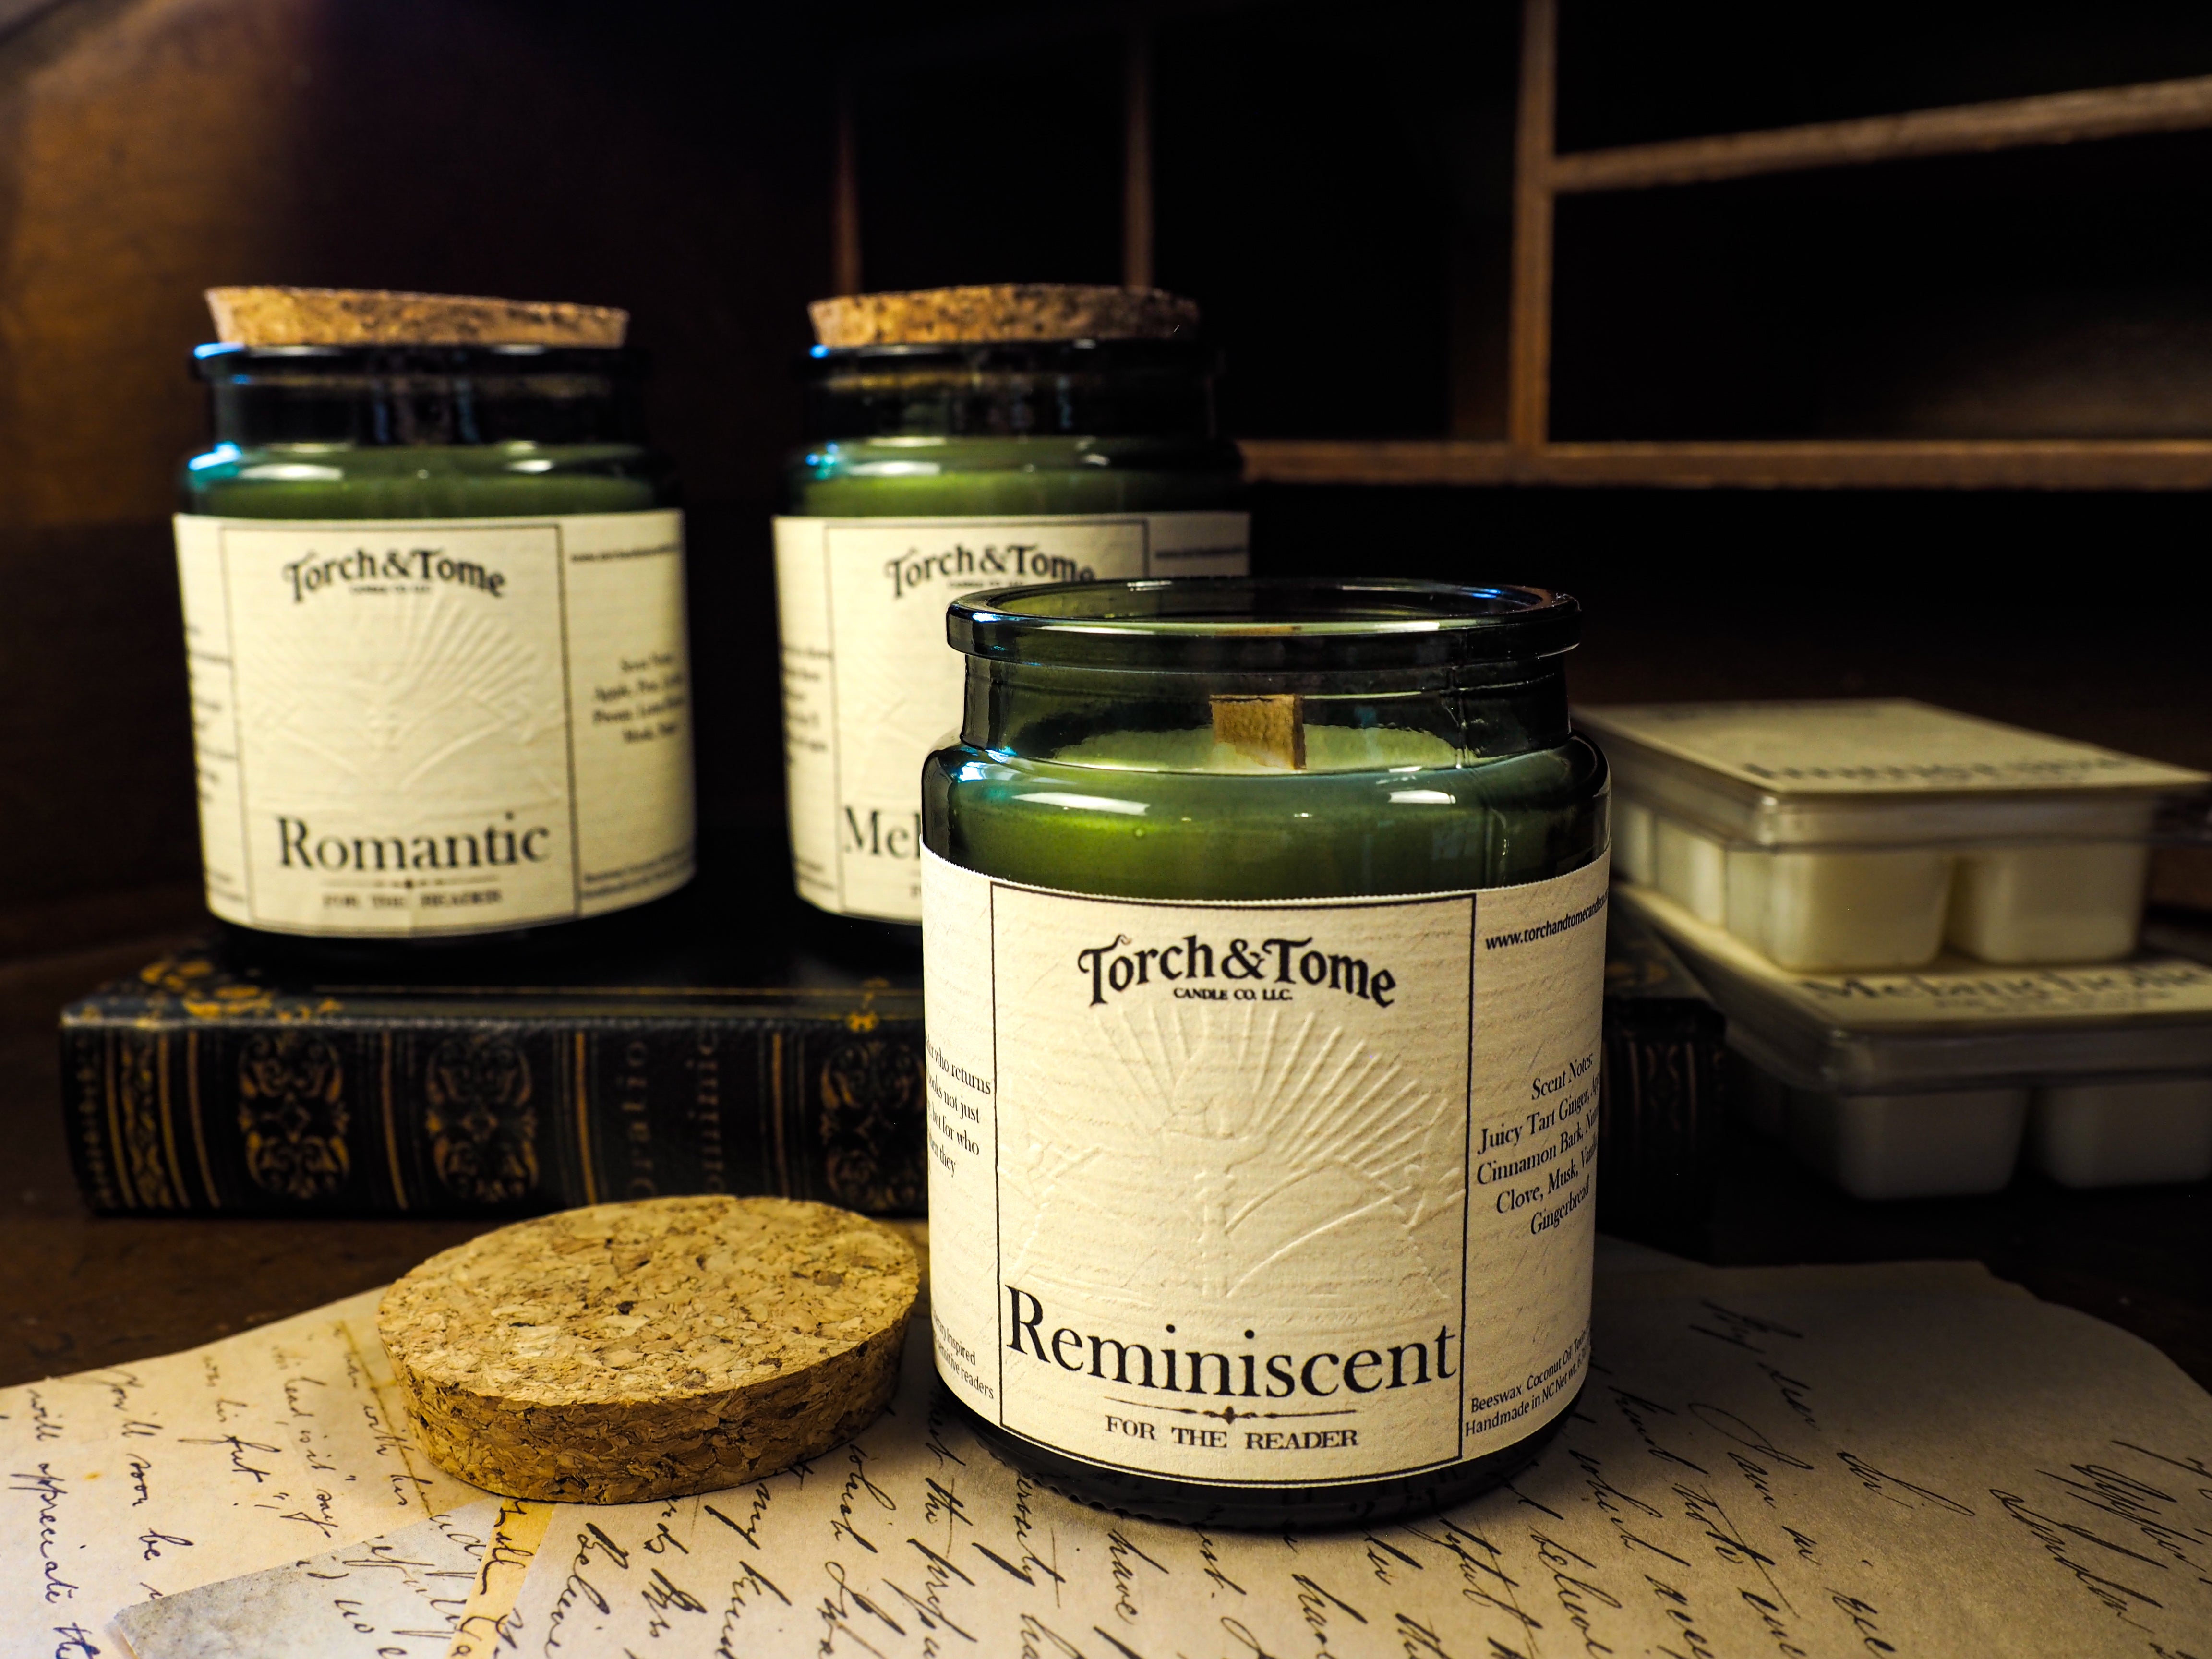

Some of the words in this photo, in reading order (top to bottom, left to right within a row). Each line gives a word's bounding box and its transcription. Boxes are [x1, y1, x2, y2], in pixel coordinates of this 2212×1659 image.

[277, 811, 550, 871] Romantic
[1173, 987, 1228, 1000] CANDLE
[935, 1047, 949, 1072] who
[951, 1063, 991, 1095] returns
[1531, 1070, 1566, 1100] Scent
[1568, 1052, 1593, 1083] Notes:
[944, 1091, 958, 1112] not
[960, 1095, 980, 1124] just
[1477, 1123, 1523, 1155] Juicy
[1527, 1109, 1555, 1135] Tart
[1558, 1093, 1590, 1121] Ginger,
[942, 1115, 954, 1141] for
[956, 1129, 979, 1155] who
[1477, 1144, 1557, 1185] Cinnamon
[1560, 1122, 1584, 1154] Bark,
[939, 1144, 956, 1178] they
[1496, 1184, 1544, 1214] Clove,
[1547, 1159, 1578, 1195] Musk,
[1530, 1174, 1589, 1235] Gingerbread
[947, 1327, 976, 1366] Inspired
[1004, 1285, 1456, 1398] Reminiscent
[961, 1368, 994, 1400] readers
[1471, 1385, 1522, 1413] Beeswax
[1527, 1358, 1562, 1391] Coconut
[1106, 1415, 1156, 1441] FOR
[1171, 1426, 1227, 1449] THE
[1245, 1429, 1359, 1450] READER
[1465, 1400, 1530, 1437] Handmade
[1531, 1395, 1540, 1409] in
[1542, 1382, 1555, 1403] NC
[138, 1527, 194, 1563] be
